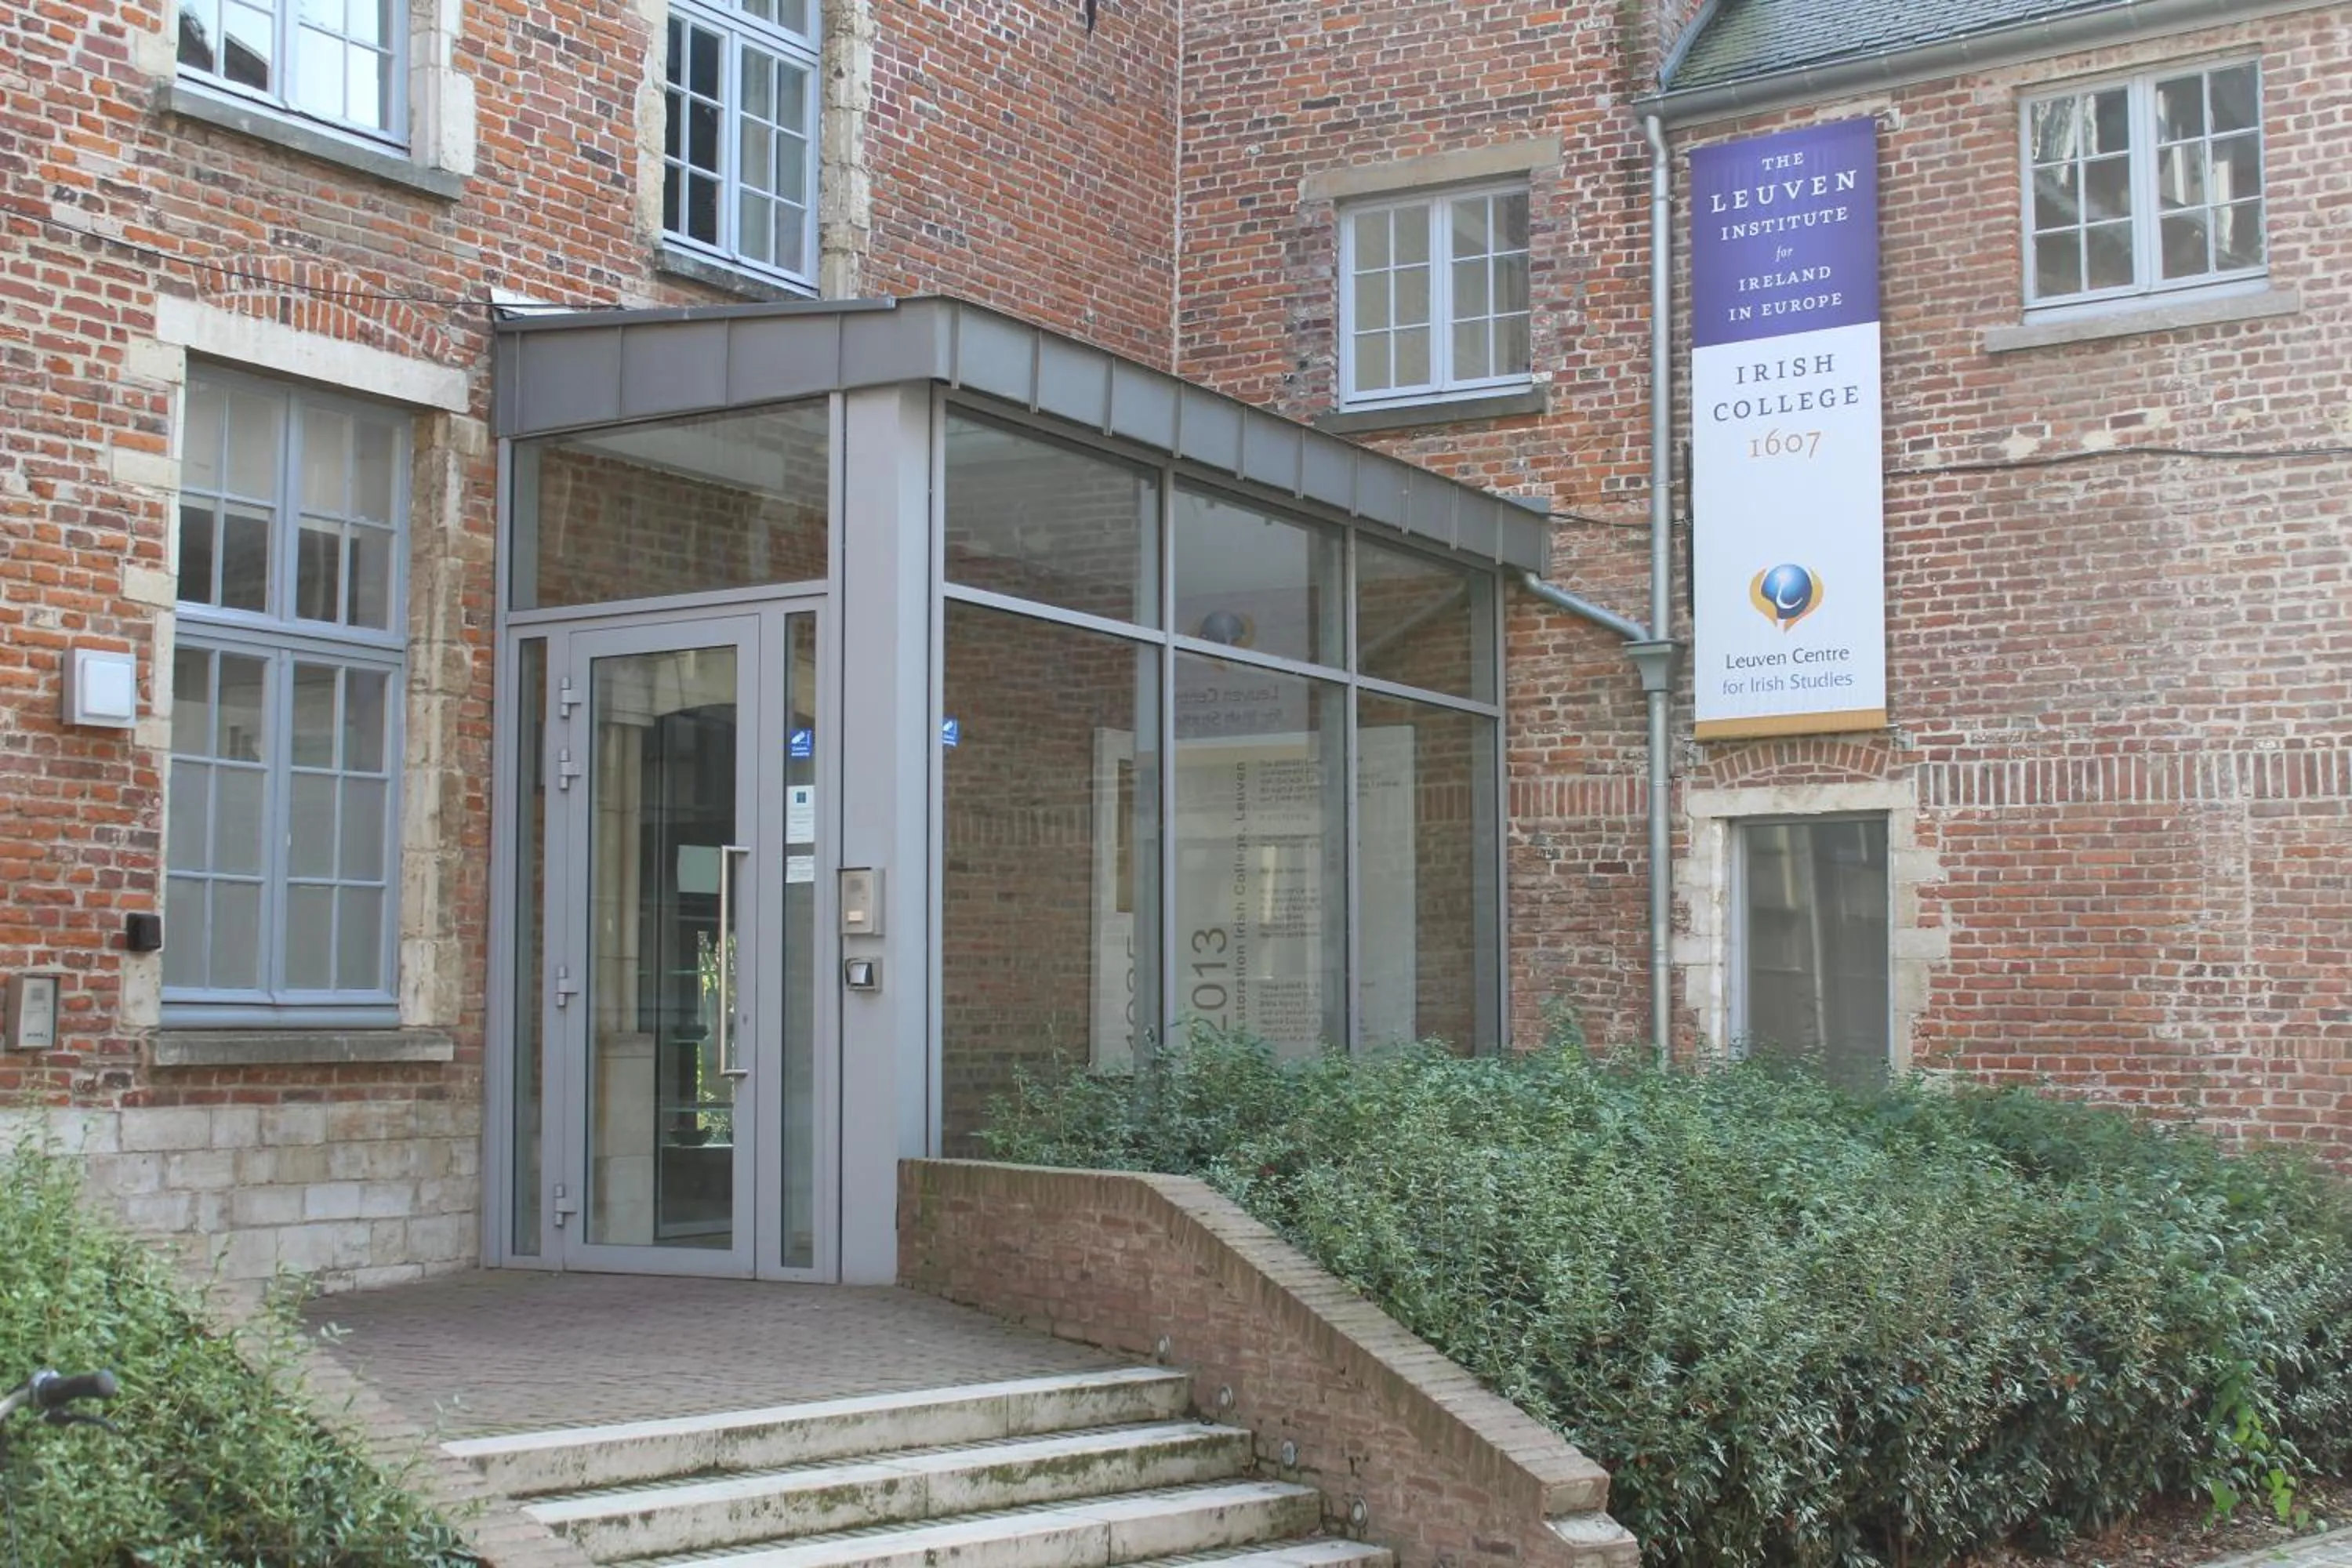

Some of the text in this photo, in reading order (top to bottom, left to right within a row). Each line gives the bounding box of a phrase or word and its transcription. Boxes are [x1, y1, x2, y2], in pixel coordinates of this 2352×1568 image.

[1762, 151, 1804, 171] THE
[1710, 169, 1858, 212] LEUVEN
[1721, 206, 1849, 241] INSTITUTE
[1775, 245, 1794, 262] for
[1738, 266, 1831, 292] IRELAND
[1729, 292, 1842, 321] IN EUROPE
[1735, 354, 1834, 385] IRISH
[1713, 385, 1860, 422] COLLEGE
[1749, 427, 1821, 459] 1607
[1726, 648, 1850, 670] Leuven Centre
[1722, 671, 1853, 695] for Irish Studies
[1234, 761, 1246, 822] Leuven
[1234, 902, 1247, 939] Irish
[1190, 927, 1228, 1038] 2013
